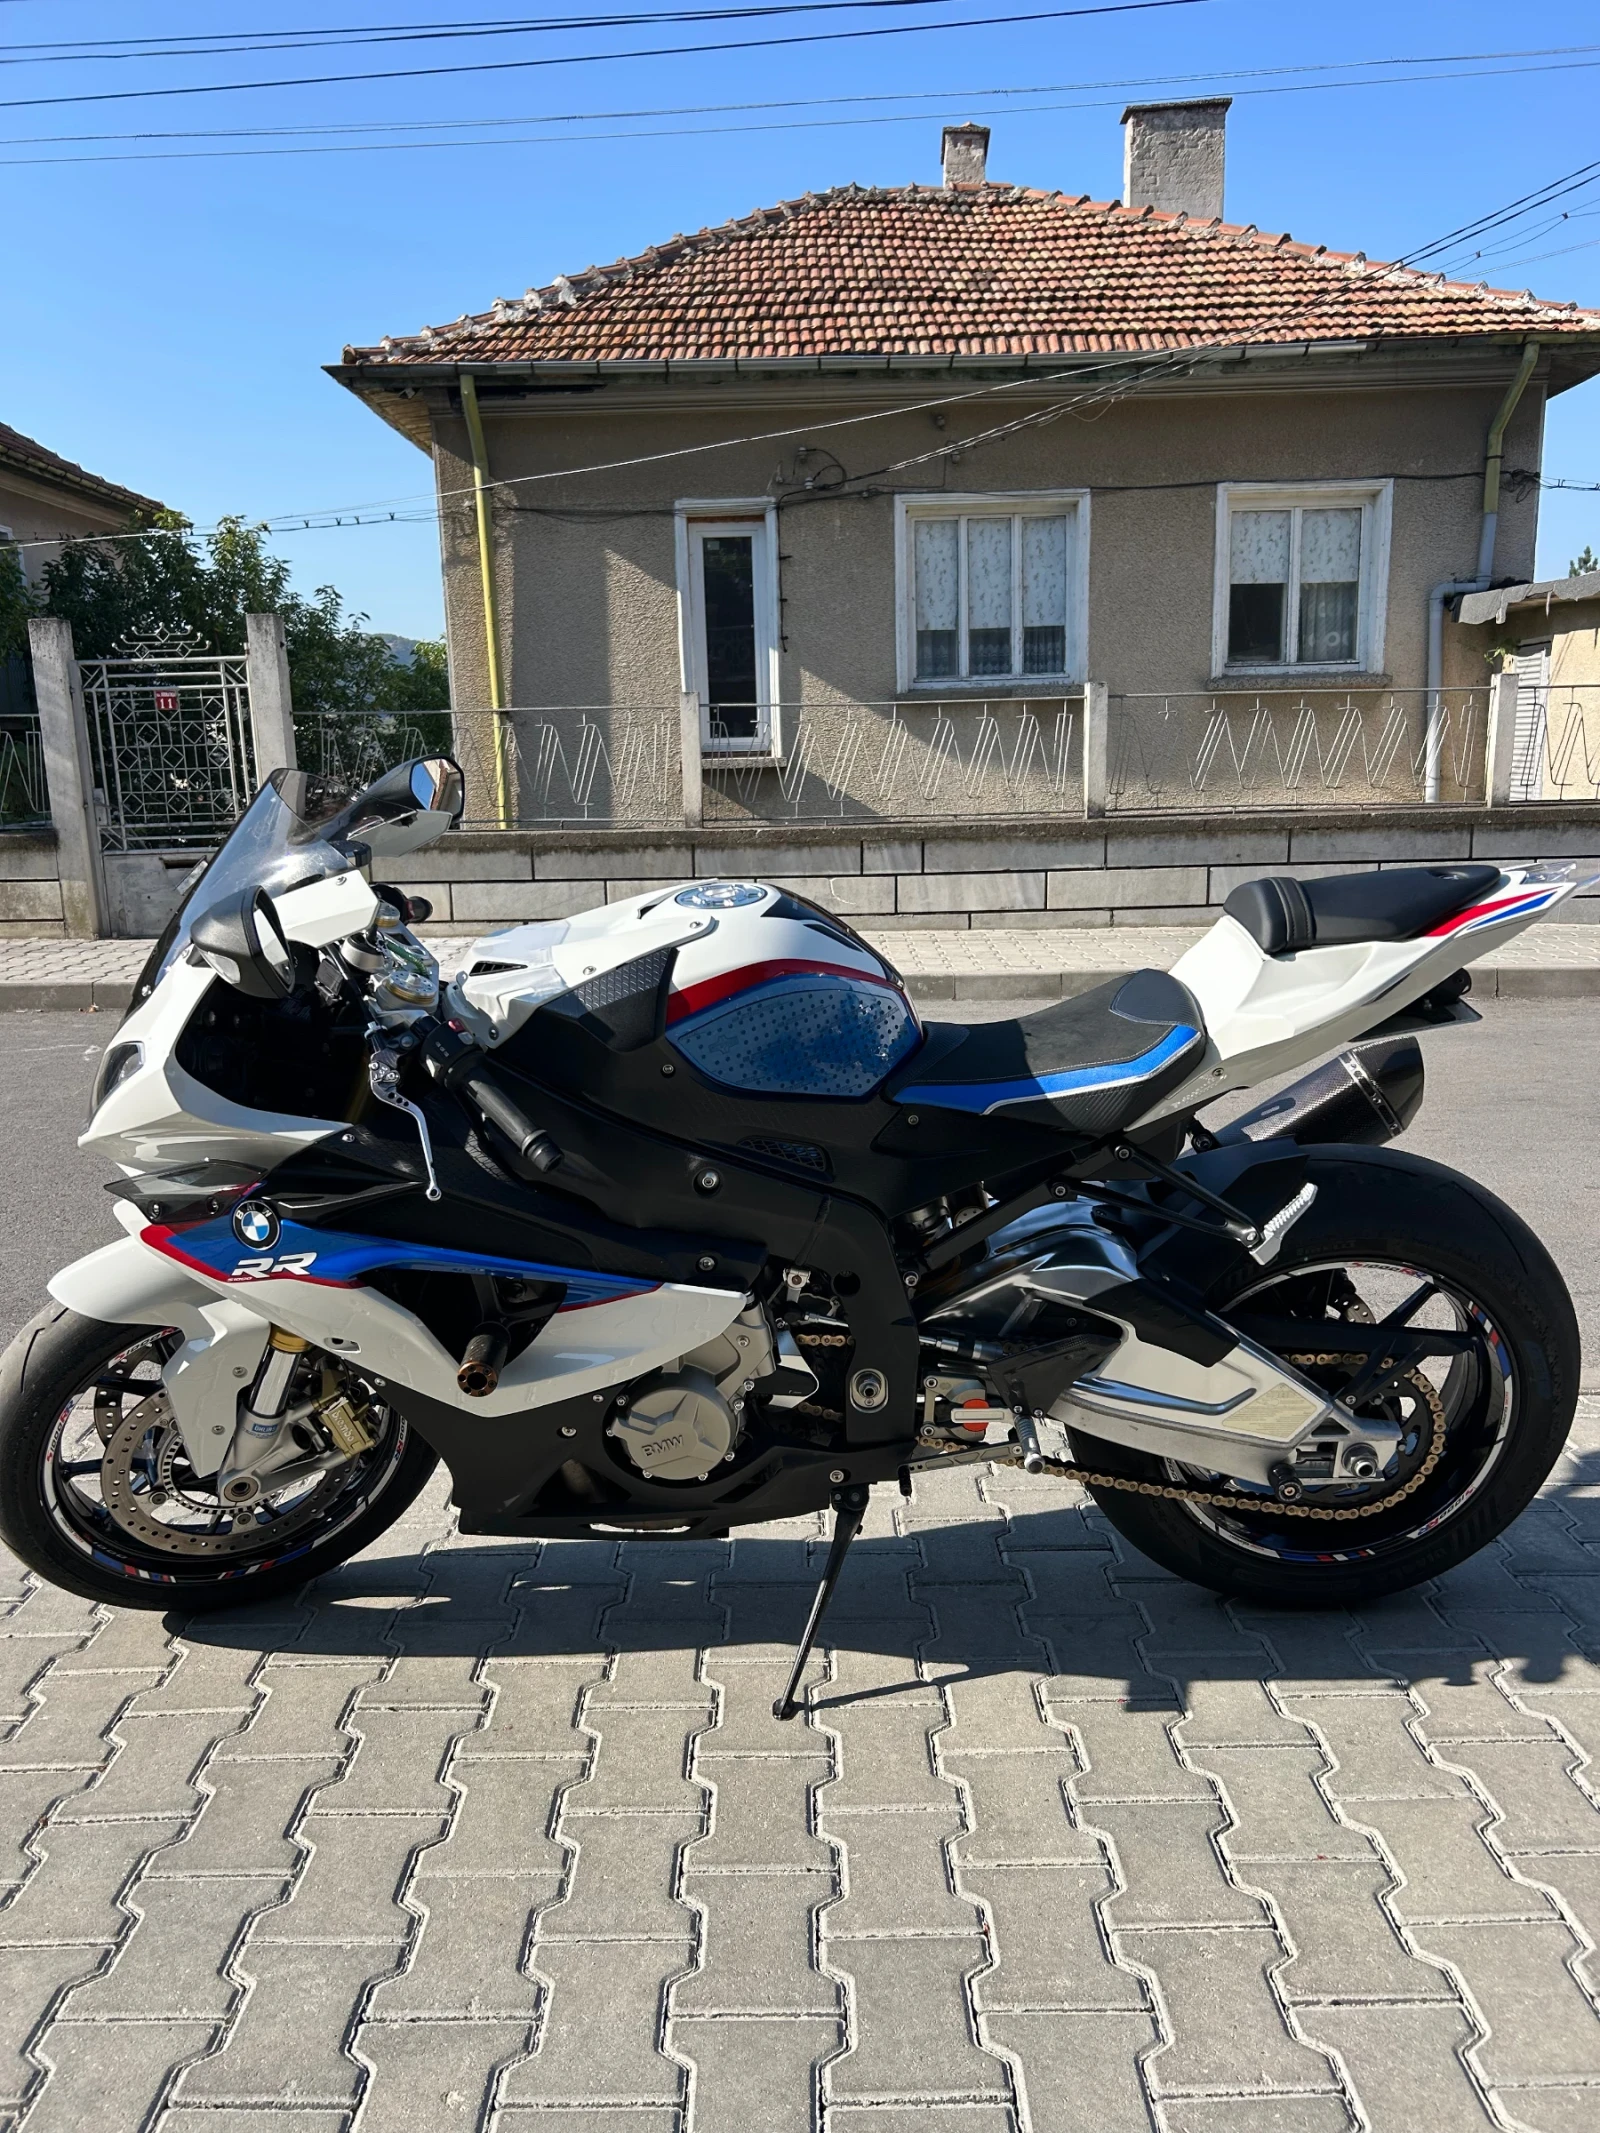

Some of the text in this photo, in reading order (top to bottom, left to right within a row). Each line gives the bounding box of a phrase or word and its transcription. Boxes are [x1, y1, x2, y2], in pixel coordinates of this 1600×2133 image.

[160, 698, 173, 709] 11
[231, 1252, 317, 1279] RR
[331, 1410, 355, 1443] brembo
[641, 1434, 685, 1457] BMW
